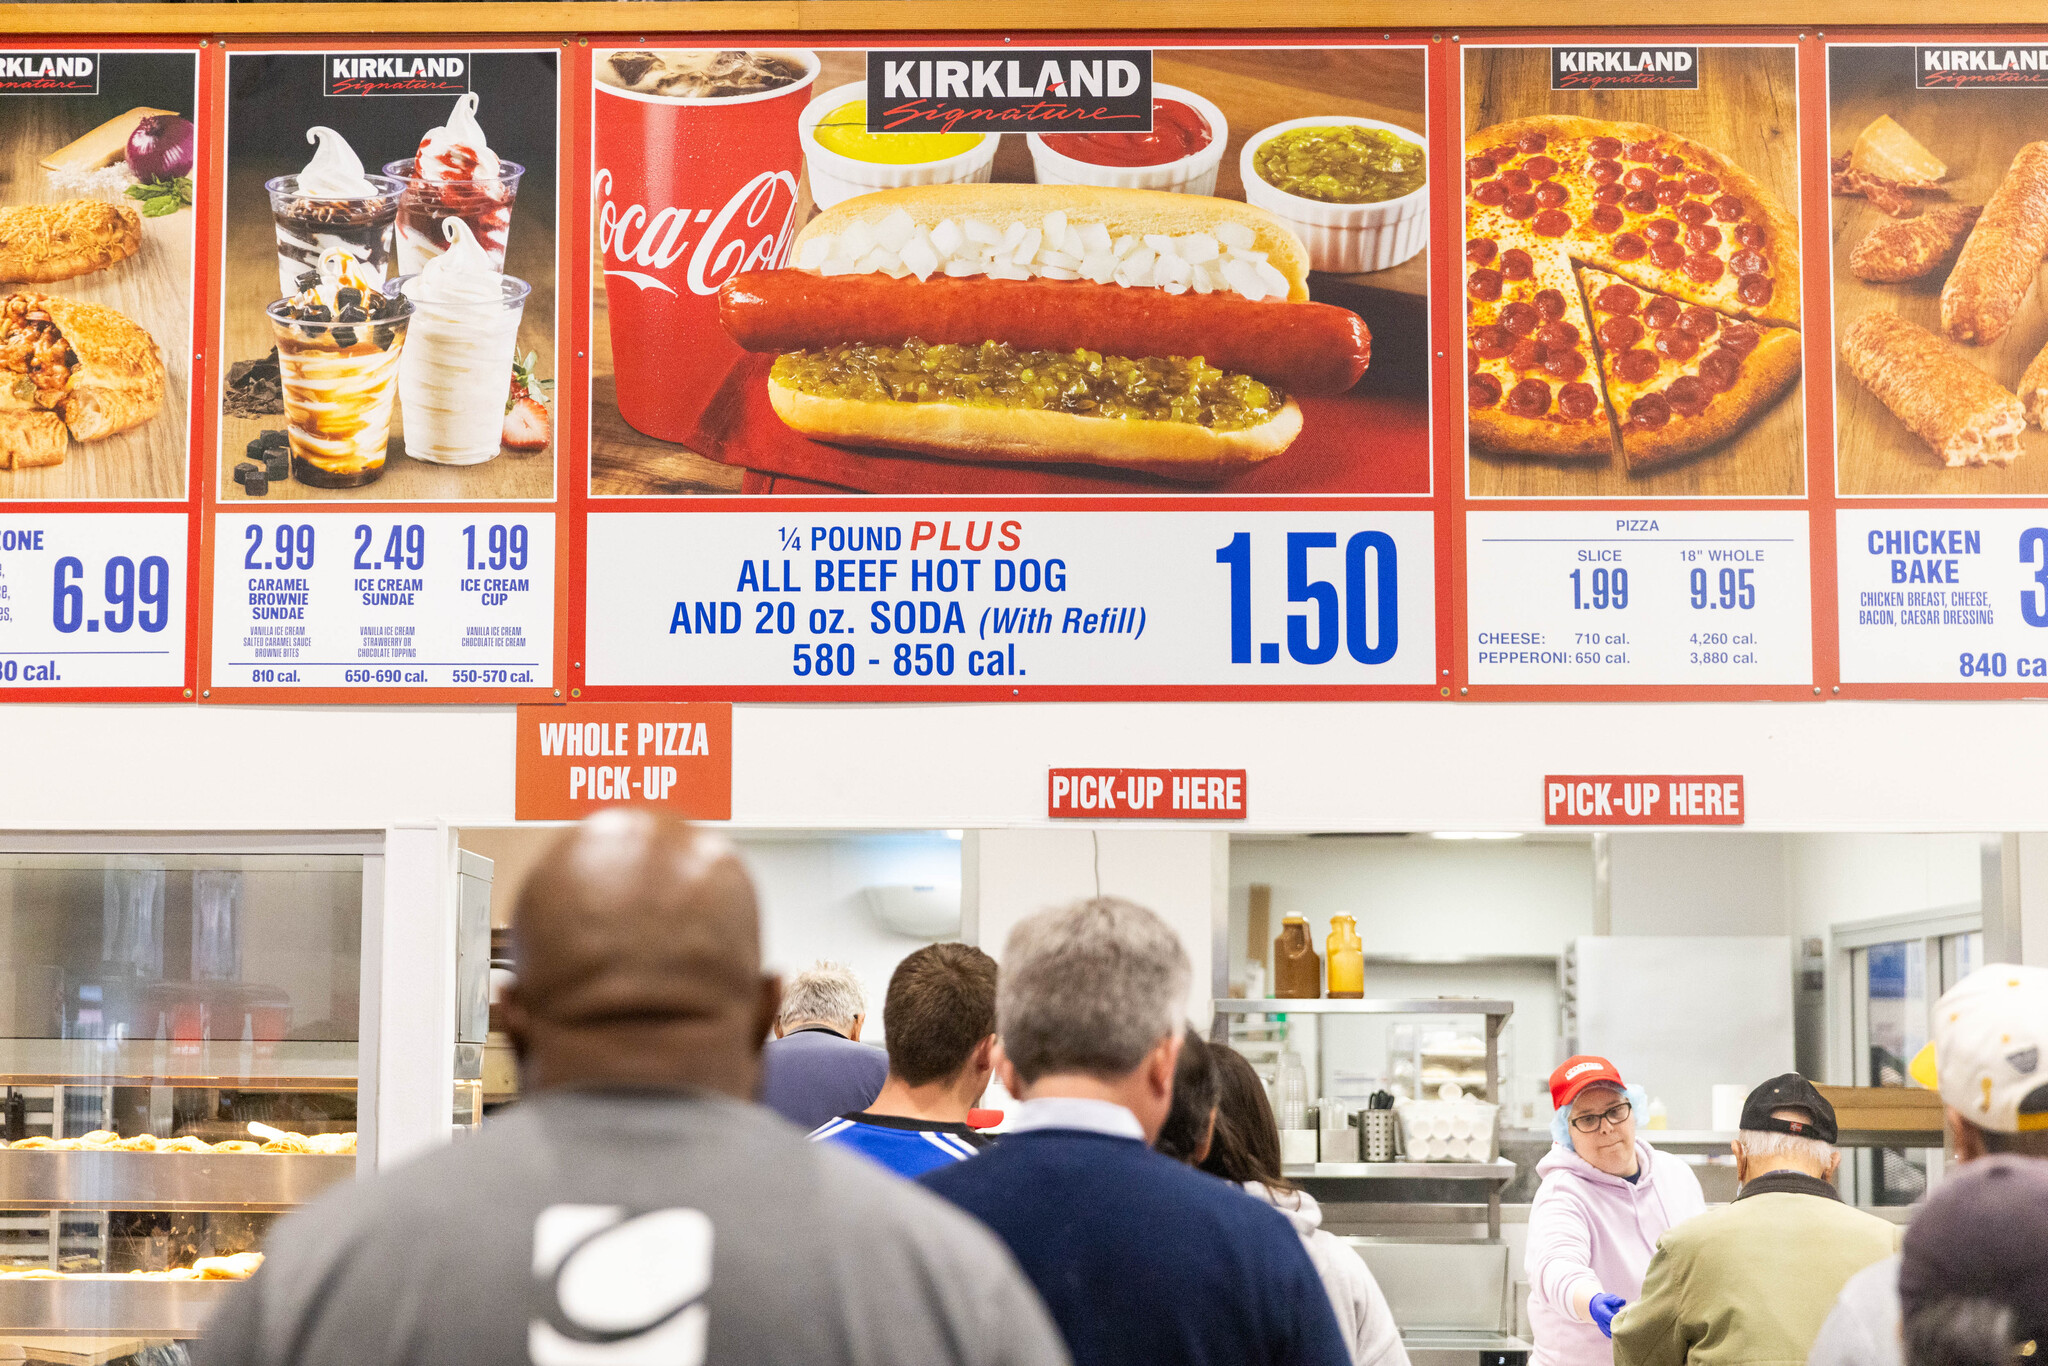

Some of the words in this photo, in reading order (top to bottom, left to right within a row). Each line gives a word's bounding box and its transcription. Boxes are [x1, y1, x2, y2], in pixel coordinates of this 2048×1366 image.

[331, 57, 465, 80] KIRKLAND
[1560, 50, 1692, 73] KIRKLAND
[0, 78, 92, 89] nature
[883, 59, 1142, 99] KIRKLAND
[1559, 72, 1692, 91] Signature
[1925, 69, 2048, 89] Signature
[332, 78, 464, 97] Signature
[882, 98, 1141, 135] Signature
[1617, 520, 1659, 531] PIZZA
[0, 530, 44, 551] ONE
[812, 526, 901, 551] POUND
[910, 520, 1022, 551] PLUS
[1868, 530, 1980, 555] CHICKEN
[245, 524, 315, 570] 2.99
[354, 524, 424, 570] 2.49
[463, 525, 528, 570] 1.99
[1578, 550, 1622, 561] SLICE
[1681, 550, 1702, 561] 18"
[1708, 550, 1764, 561] WHOLE
[737, 560, 801, 592] ALL
[815, 560, 897, 592] BEEF
[912, 559, 981, 592] HOT
[995, 558, 1066, 592] DOG
[1891, 560, 1959, 583] BAKE
[0, 585, 10, 599] e,
[249, 578, 309, 591] CARAMEL
[355, 579, 374, 591] ICE
[378, 579, 423, 591] CREAM
[461, 579, 480, 591] ICE
[484, 579, 529, 591] CREAM
[1570, 568, 1628, 609] 1.99
[1690, 568, 1755, 609] 9.95
[53, 556, 169, 633] 6.99
[249, 593, 308, 605] BROWNIE
[362, 593, 414, 605] SUNDAE
[482, 593, 508, 606] CUP
[1216, 530, 1398, 665] 1.50
[1861, 592, 1903, 606] CHICKEN
[1908, 592, 1947, 608] BREAST,
[1952, 592, 1991, 608] CHEESE,
[253, 607, 304, 620] SUNDAE
[669, 602, 741, 634] AND
[755, 601, 795, 634] 20
[809, 609, 854, 634] oz.
[871, 600, 966, 634] SODA
[980, 607, 1052, 640] (With
[1062, 607, 1146, 640] Refill)
[1860, 610, 1896, 626] BACON,
[1901, 610, 1939, 624] CAESAR
[1944, 610, 1993, 624] DRESSING
[251, 627, 273, 635] VANILLA
[275, 627, 283, 635] ICE
[285, 627, 305, 635] CREAM
[360, 627, 383, 635] VANILLA
[385, 627, 393, 635] ICE
[395, 627, 415, 635] CREAM
[467, 627, 489, 636] VANILLA
[491, 627, 499, 636] ICE
[501, 627, 521, 636] CREAM
[1479, 633, 1544, 644] CHEESE:
[1575, 633, 1600, 644] 710
[1605, 633, 1629, 644] cal.
[1690, 633, 1727, 645] 4,260
[1733, 633, 1757, 644] cal.
[244, 637, 263, 646] SALTED
[265, 637, 291, 646] CARAMEL
[293, 638, 311, 646] SAUCE
[364, 638, 402, 646] STRAWBERRY
[404, 637, 411, 646] OR
[462, 638, 493, 646] CHOCOLATE
[495, 638, 503, 646] ICE
[506, 638, 525, 646] CREAM
[255, 648, 281, 657] BROWNIE
[283, 648, 299, 657] BITES
[358, 648, 389, 657] CHOCOLATE
[392, 648, 416, 657] TOPPING
[793, 643, 855, 676] 580
[894, 643, 954, 676] 850
[969, 643, 1026, 676] cal.
[1479, 652, 1571, 663] PEPPERONI:
[1576, 652, 1600, 663] 650
[1606, 652, 1629, 663] cal.
[1691, 652, 1728, 664] 3,880
[1733, 652, 1757, 663] cal.
[0, 660, 17, 681] 0
[23, 660, 61, 681] cal.
[1960, 653, 2006, 677] 840
[252, 669, 274, 682] 810
[277, 670, 300, 682] cal.
[345, 670, 401, 682] 650-690
[405, 670, 428, 682] cal.
[453, 670, 507, 682] 550-570
[510, 670, 533, 682] cal.
[540, 723, 628, 756] WHOLE
[638, 723, 709, 755] PIZZA
[570, 766, 677, 800] PICK-UP
[1053, 776, 1163, 809] PICK-UP
[1173, 777, 1241, 809] HERE
[1549, 783, 1660, 816] PICK-UP
[1669, 783, 1739, 815] HERE
